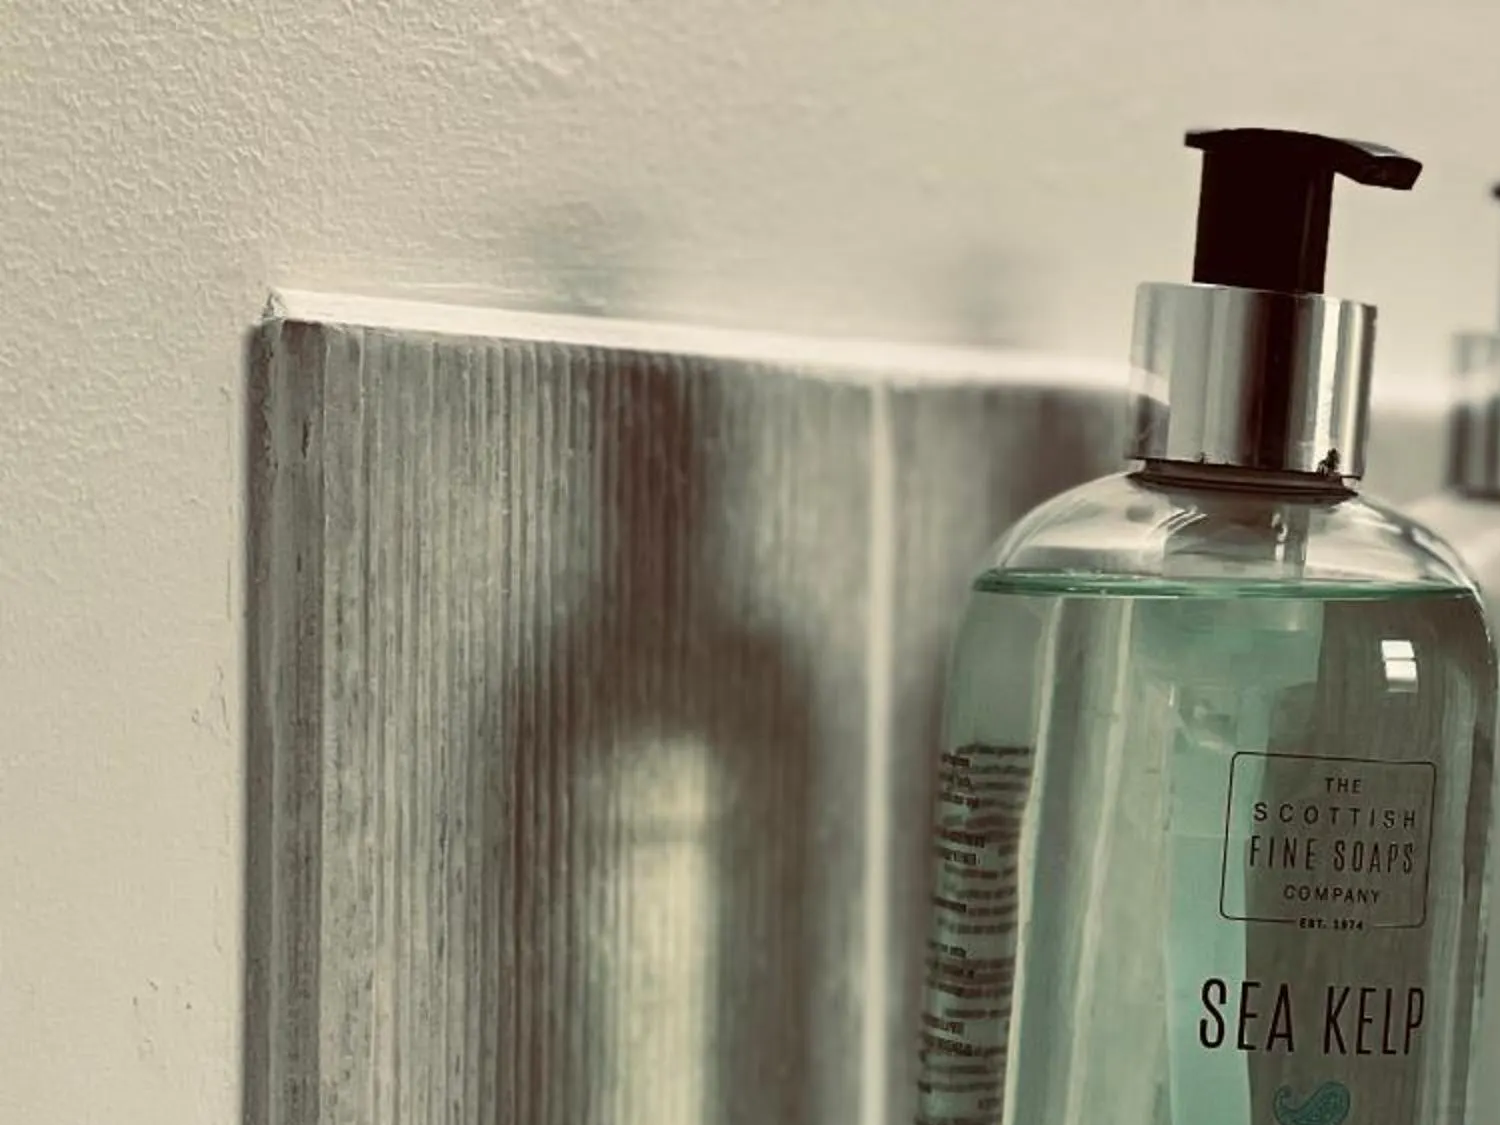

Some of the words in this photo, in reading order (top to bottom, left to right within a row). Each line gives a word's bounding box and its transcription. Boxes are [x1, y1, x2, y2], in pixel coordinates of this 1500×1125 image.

[1325, 777, 1361, 793] THE
[1254, 803, 1416, 829] SCOTTISH
[1250, 835, 1318, 872] FINE
[1333, 839, 1415, 874] SOAPS
[1283, 884, 1381, 905] COMPANY
[1199, 977, 1295, 1053] SEA
[1323, 985, 1425, 1056] KELP
